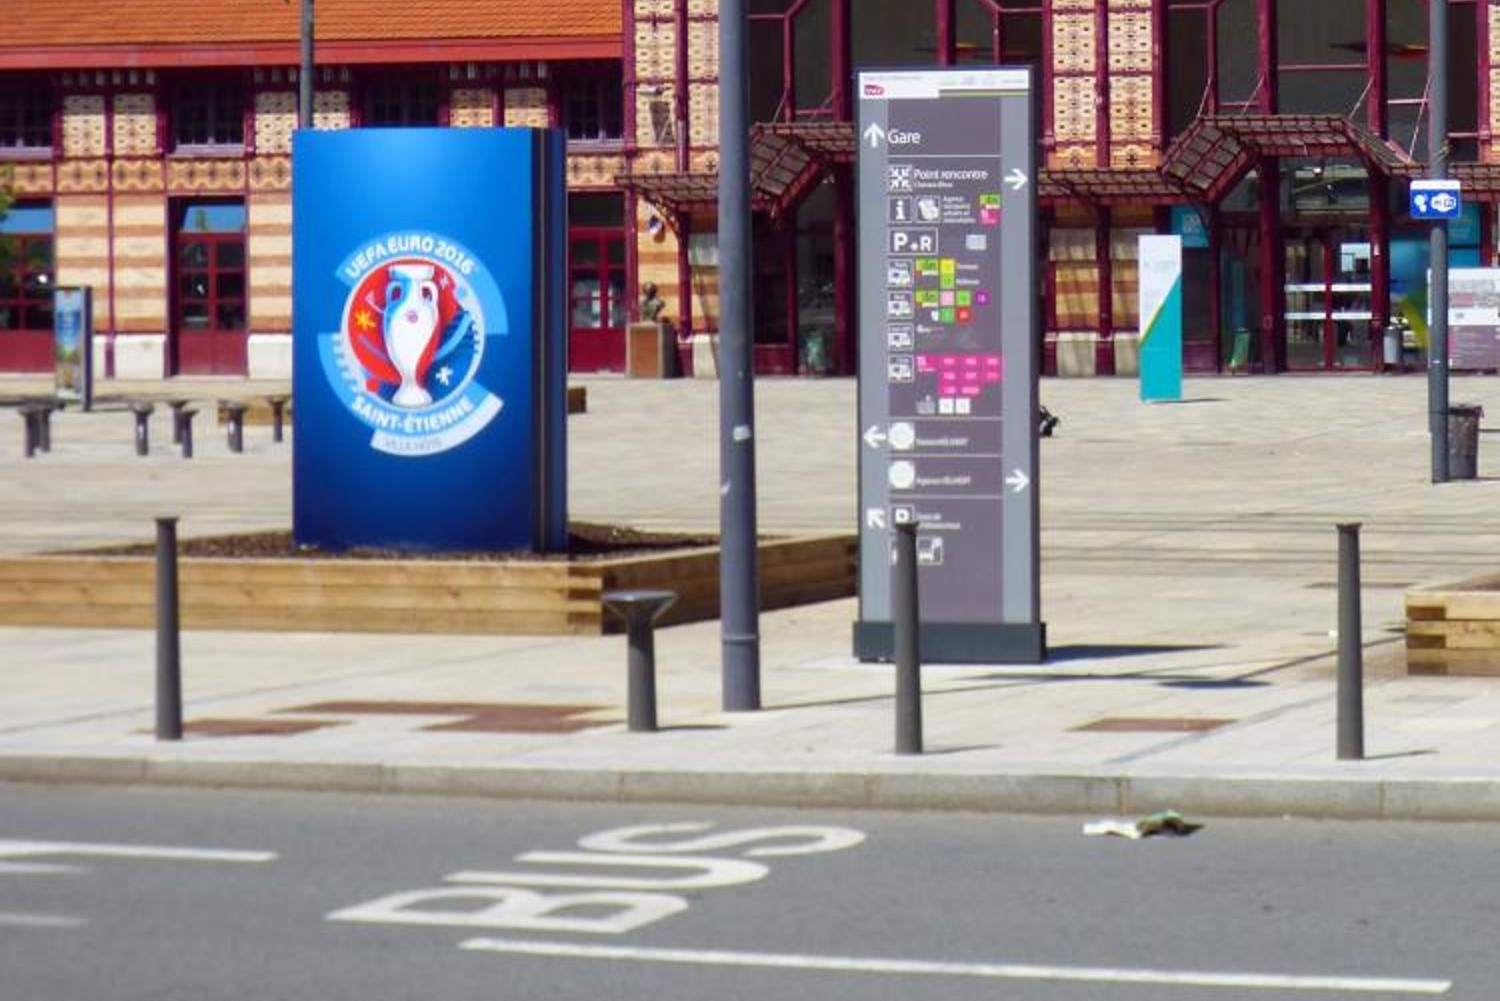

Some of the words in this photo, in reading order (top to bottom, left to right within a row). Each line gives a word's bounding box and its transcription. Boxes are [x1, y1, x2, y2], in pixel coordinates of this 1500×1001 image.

[887, 129, 922, 145] Gare
[913, 169, 939, 180] Point
[941, 169, 989, 180] rencontre
[344, 243, 387, 279] UEFA
[387, 234, 435, 254] EURO
[434, 240, 475, 275] 2016
[323, 820, 867, 935] BUS
